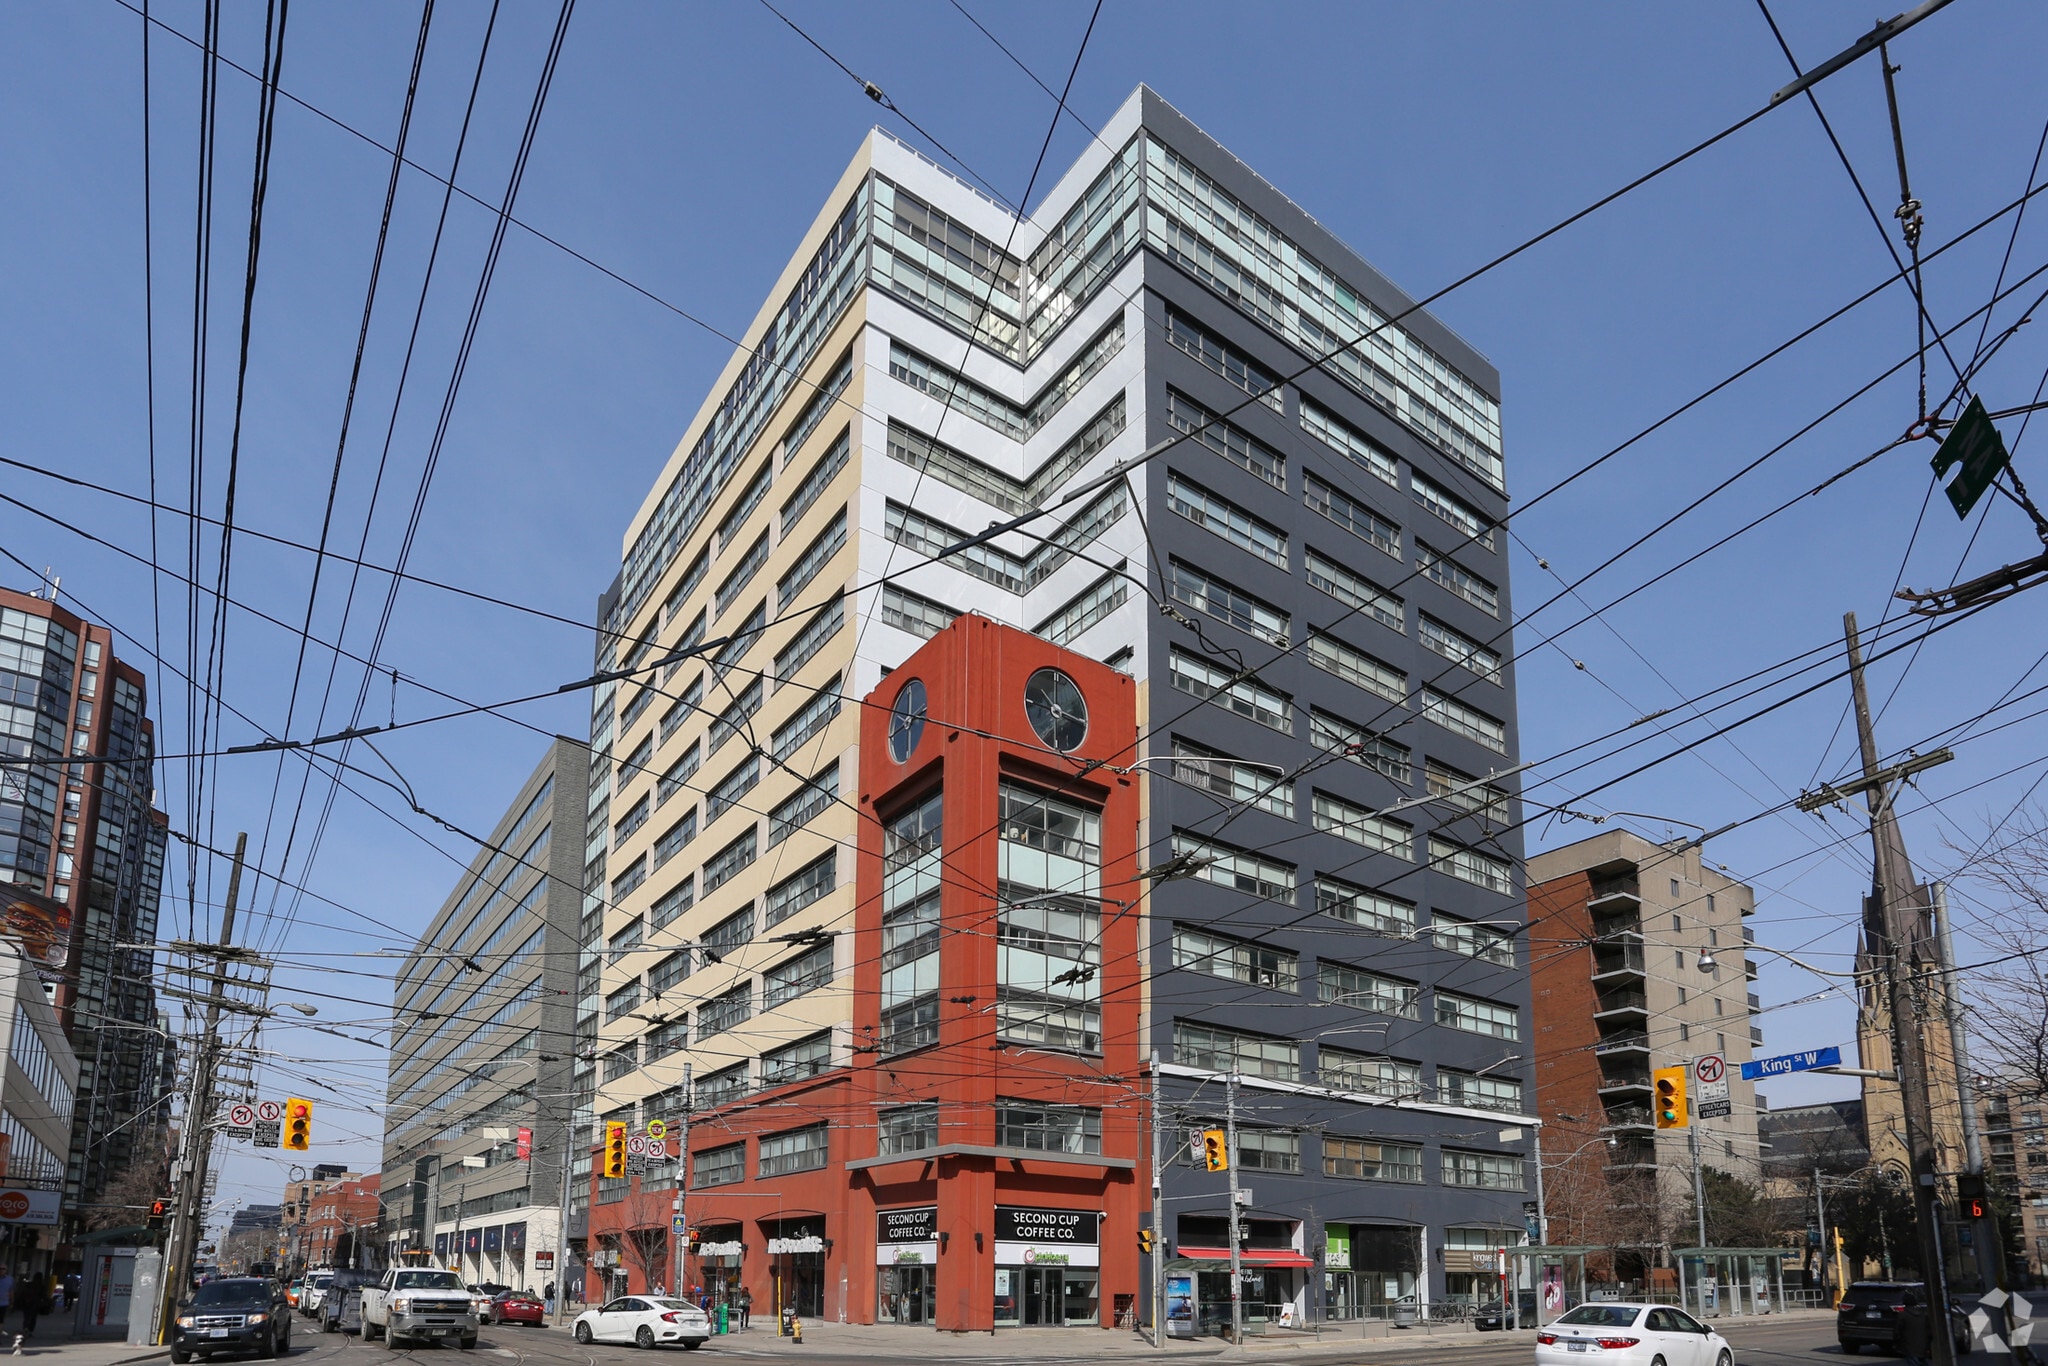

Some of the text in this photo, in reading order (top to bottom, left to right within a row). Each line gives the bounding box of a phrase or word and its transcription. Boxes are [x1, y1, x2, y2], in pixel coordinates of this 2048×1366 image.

[1761, 1051, 1817, 1074] King St W
[1699, 1101, 1730, 1112] STREETCARS
[1702, 1108, 1728, 1118] EXCEPTED
[1972, 1200, 1982, 1217] 6
[887, 1212, 929, 1225] SECOND CUP
[1013, 1212, 1080, 1226] SECOND CUP
[889, 1226, 926, 1238] COFFEE CO.
[1016, 1226, 1075, 1239] COFFEE CO.
